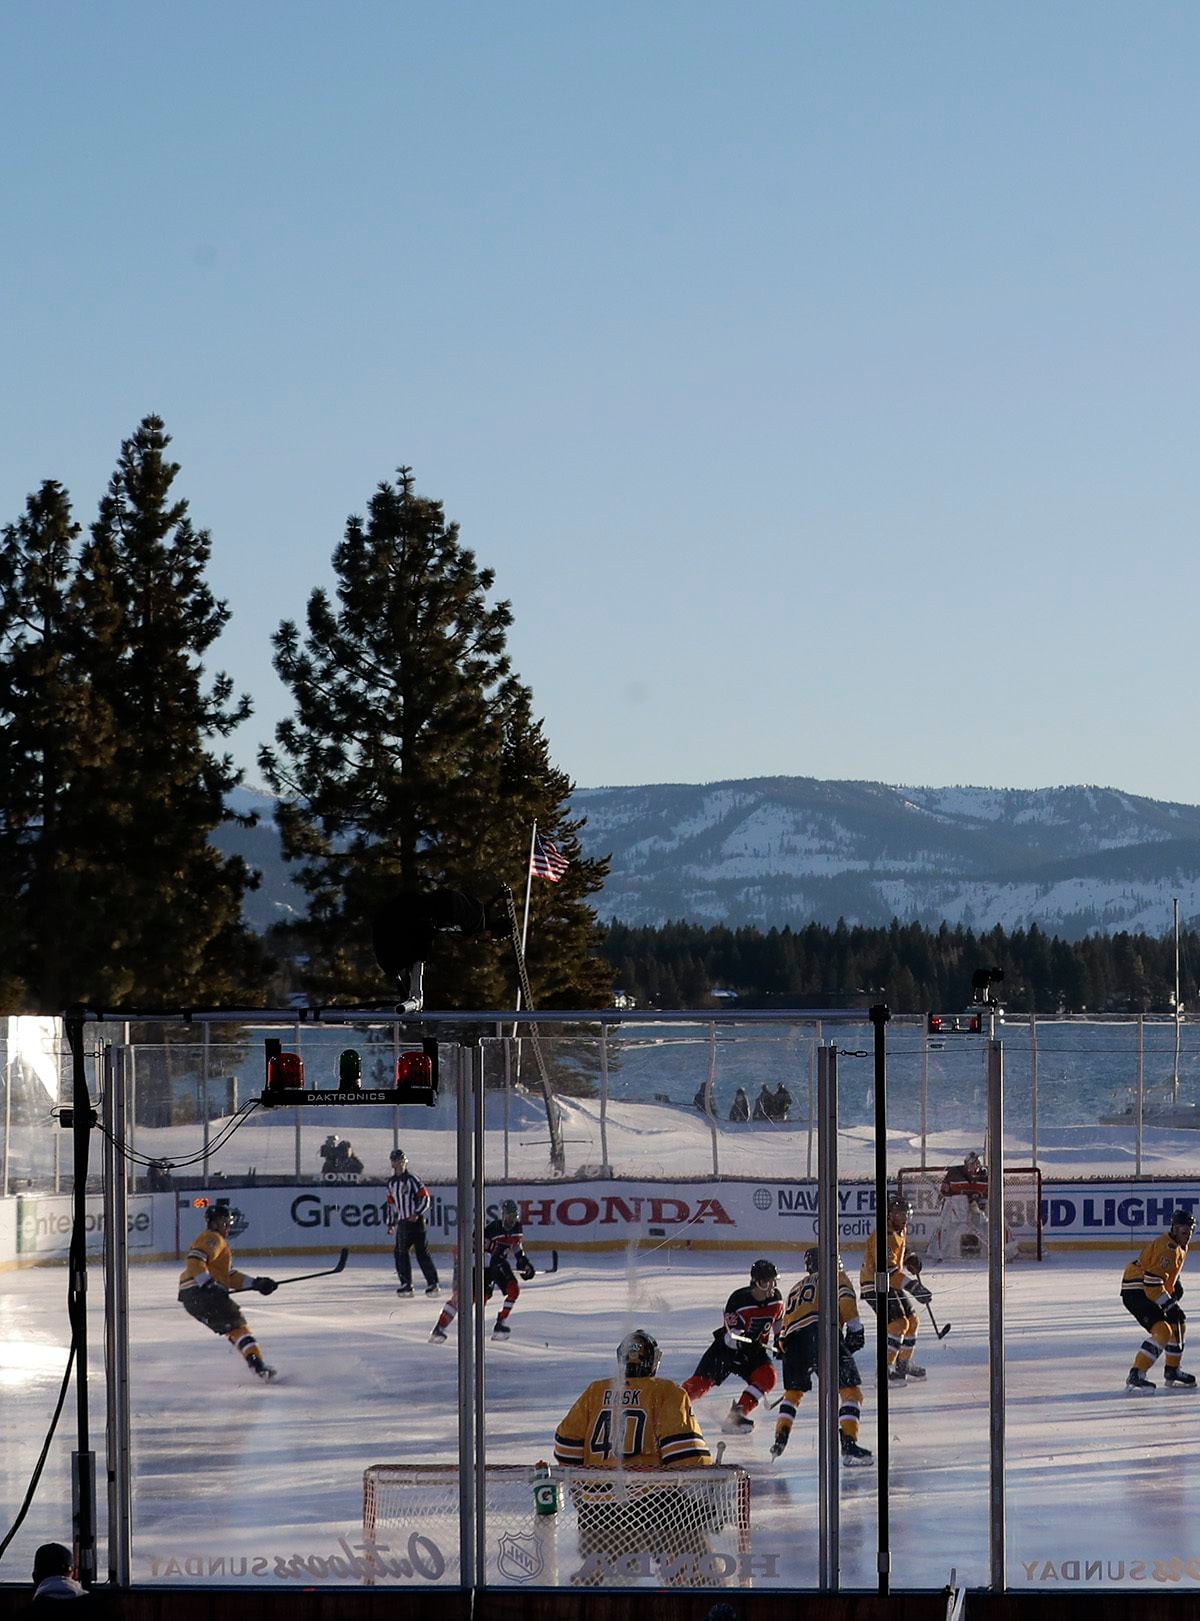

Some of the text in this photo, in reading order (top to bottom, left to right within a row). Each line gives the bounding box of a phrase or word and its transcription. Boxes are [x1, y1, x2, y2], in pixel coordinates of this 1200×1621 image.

[307, 1092, 386, 1102] DAKTRONICS
[395, 1194, 498, 1235] lips
[518, 1196, 737, 1227] HONDA
[1006, 1197, 1200, 1228] BUD LIGHT
[591, 1408, 648, 1460] 40
[538, 1487, 554, 1505] G
